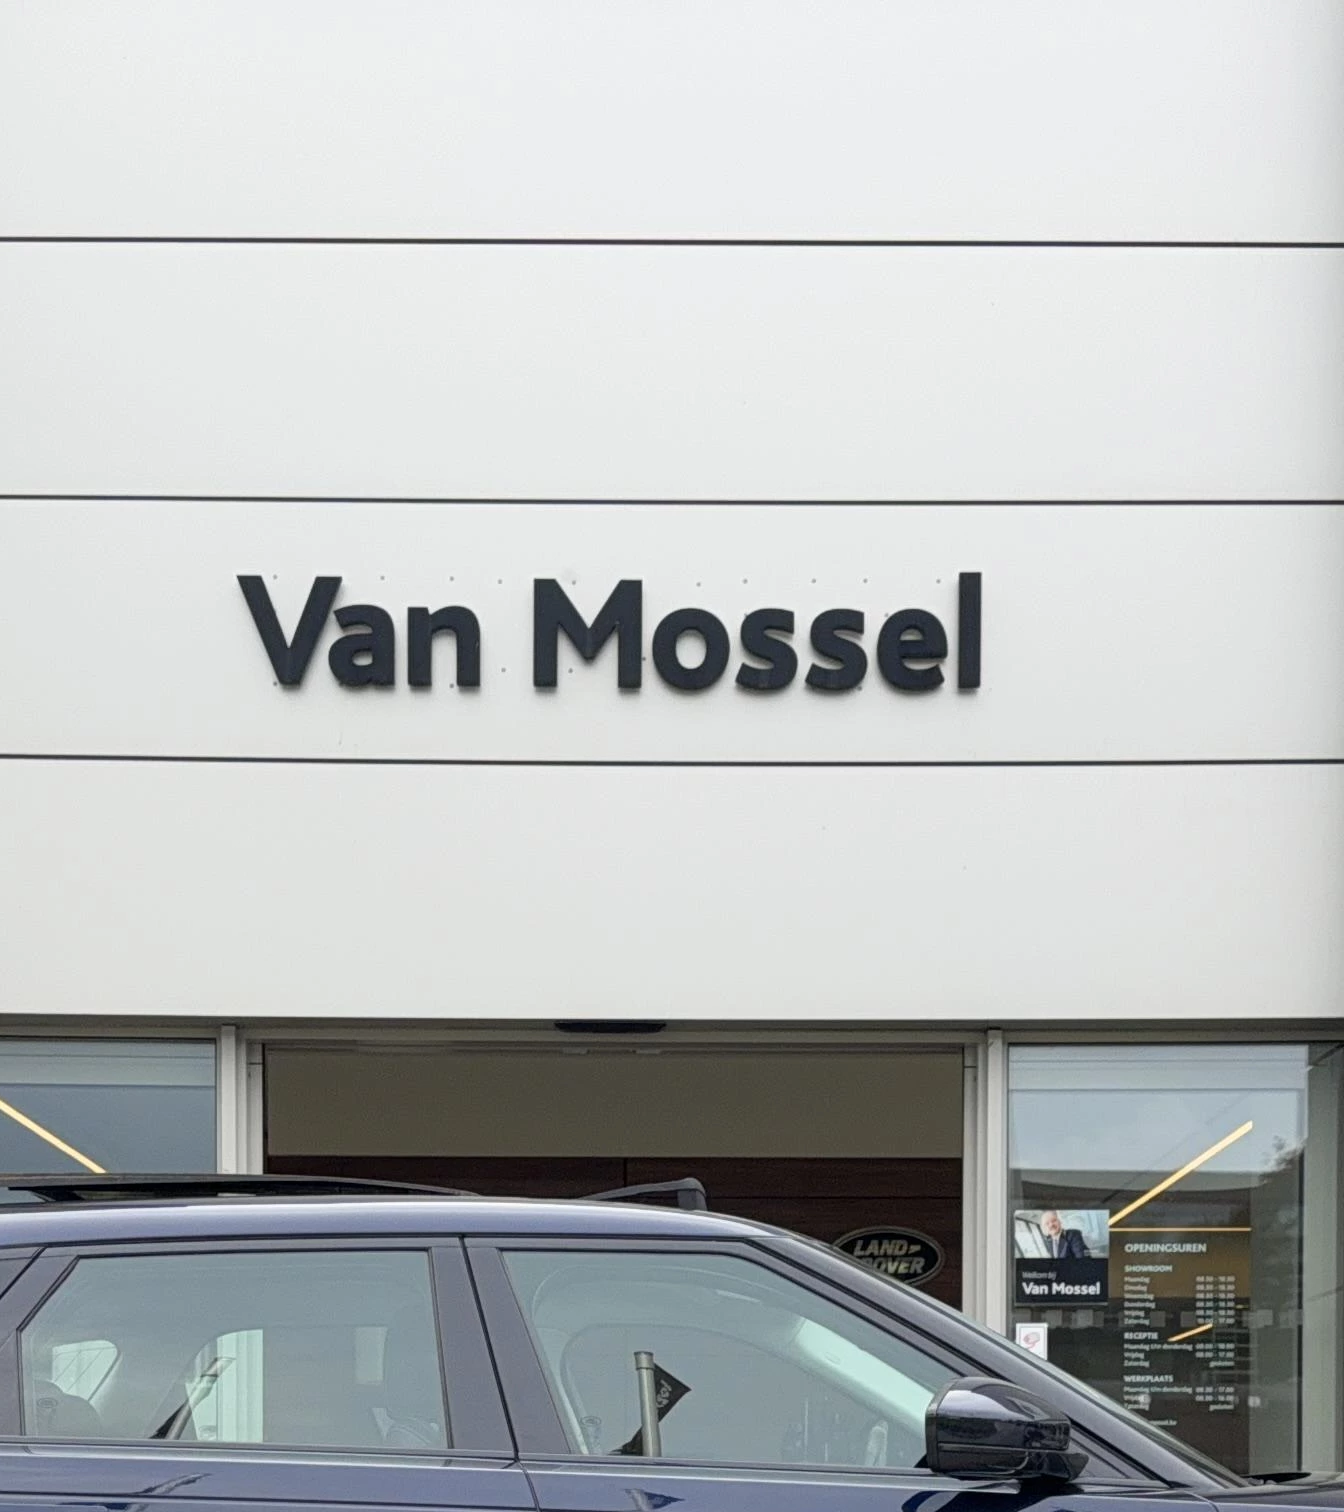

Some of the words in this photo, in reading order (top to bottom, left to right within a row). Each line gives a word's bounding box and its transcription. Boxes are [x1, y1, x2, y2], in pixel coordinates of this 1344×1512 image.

[237, 574, 481, 688] Van
[533, 571, 982, 692] Mossel
[1124, 1243, 1207, 1253] OPENINGSUREN
[1124, 1264, 1173, 1273] SHOWROOM
[1022, 1282, 1049, 1295] Van
[1051, 1281, 1101, 1295] Mossel
[1124, 1332, 1158, 1340] RECEPTIE
[1123, 1375, 1174, 1383] WERKPLAATS
